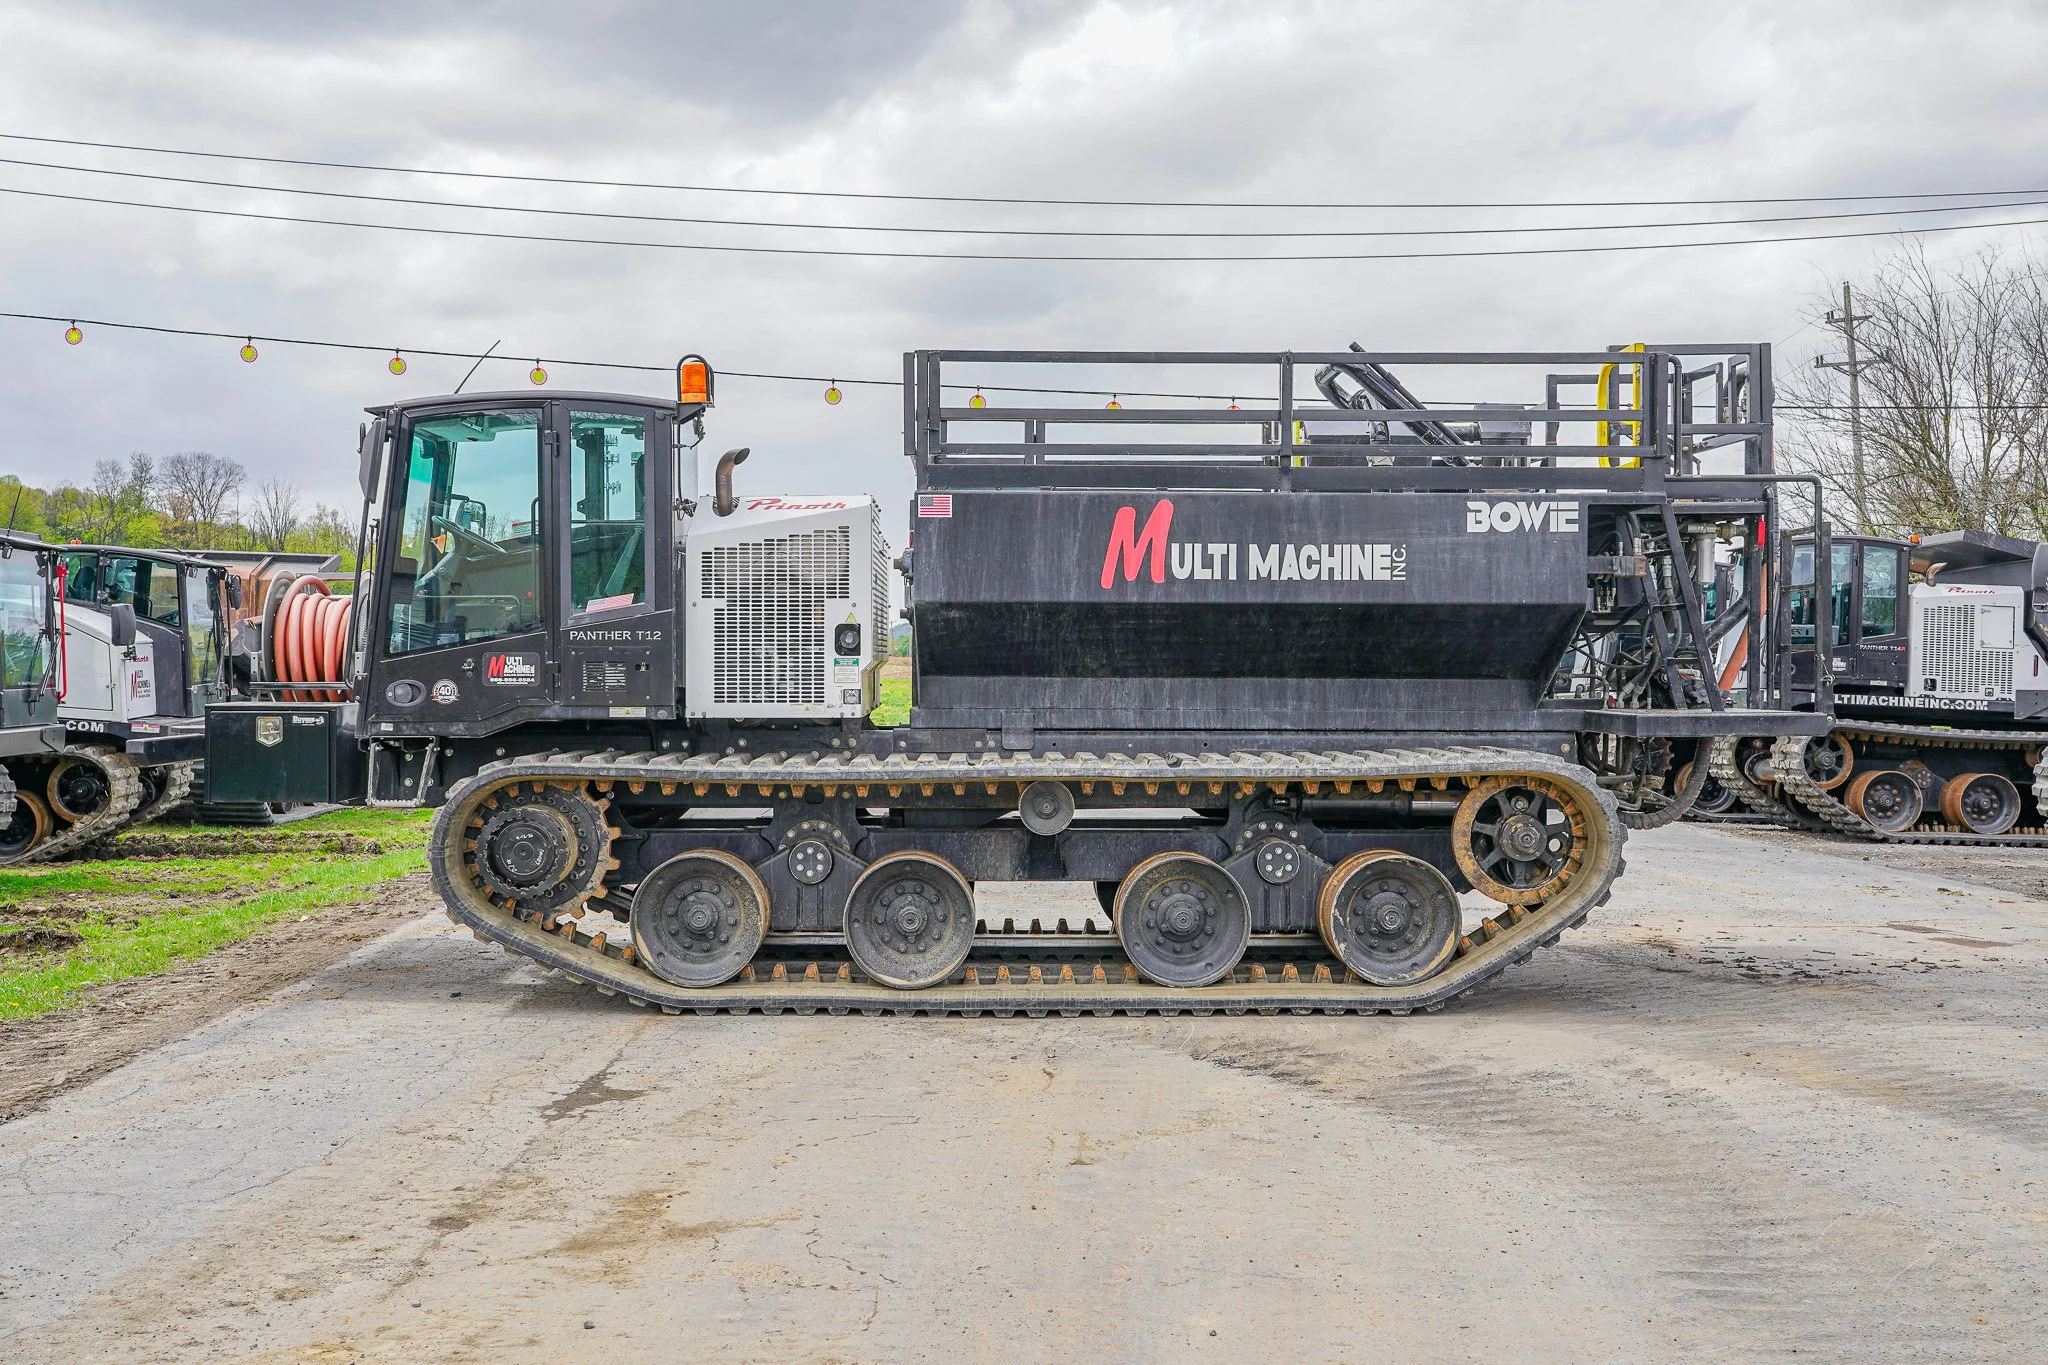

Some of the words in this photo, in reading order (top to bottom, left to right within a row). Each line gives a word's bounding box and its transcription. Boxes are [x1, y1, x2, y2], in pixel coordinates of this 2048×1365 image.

[745, 498, 846, 511] Prinoth
[1466, 501, 1579, 533] BOWIE
[1100, 498, 1237, 589] MULTI
[1248, 543, 1392, 581] MACHINE
[1392, 544, 1407, 581] INC.
[569, 630, 632, 641] PANTHER
[635, 630, 662, 641] T12
[439, 686, 452, 697] 40
[1811, 692, 1989, 711] LTIMACHINEINC.COM
